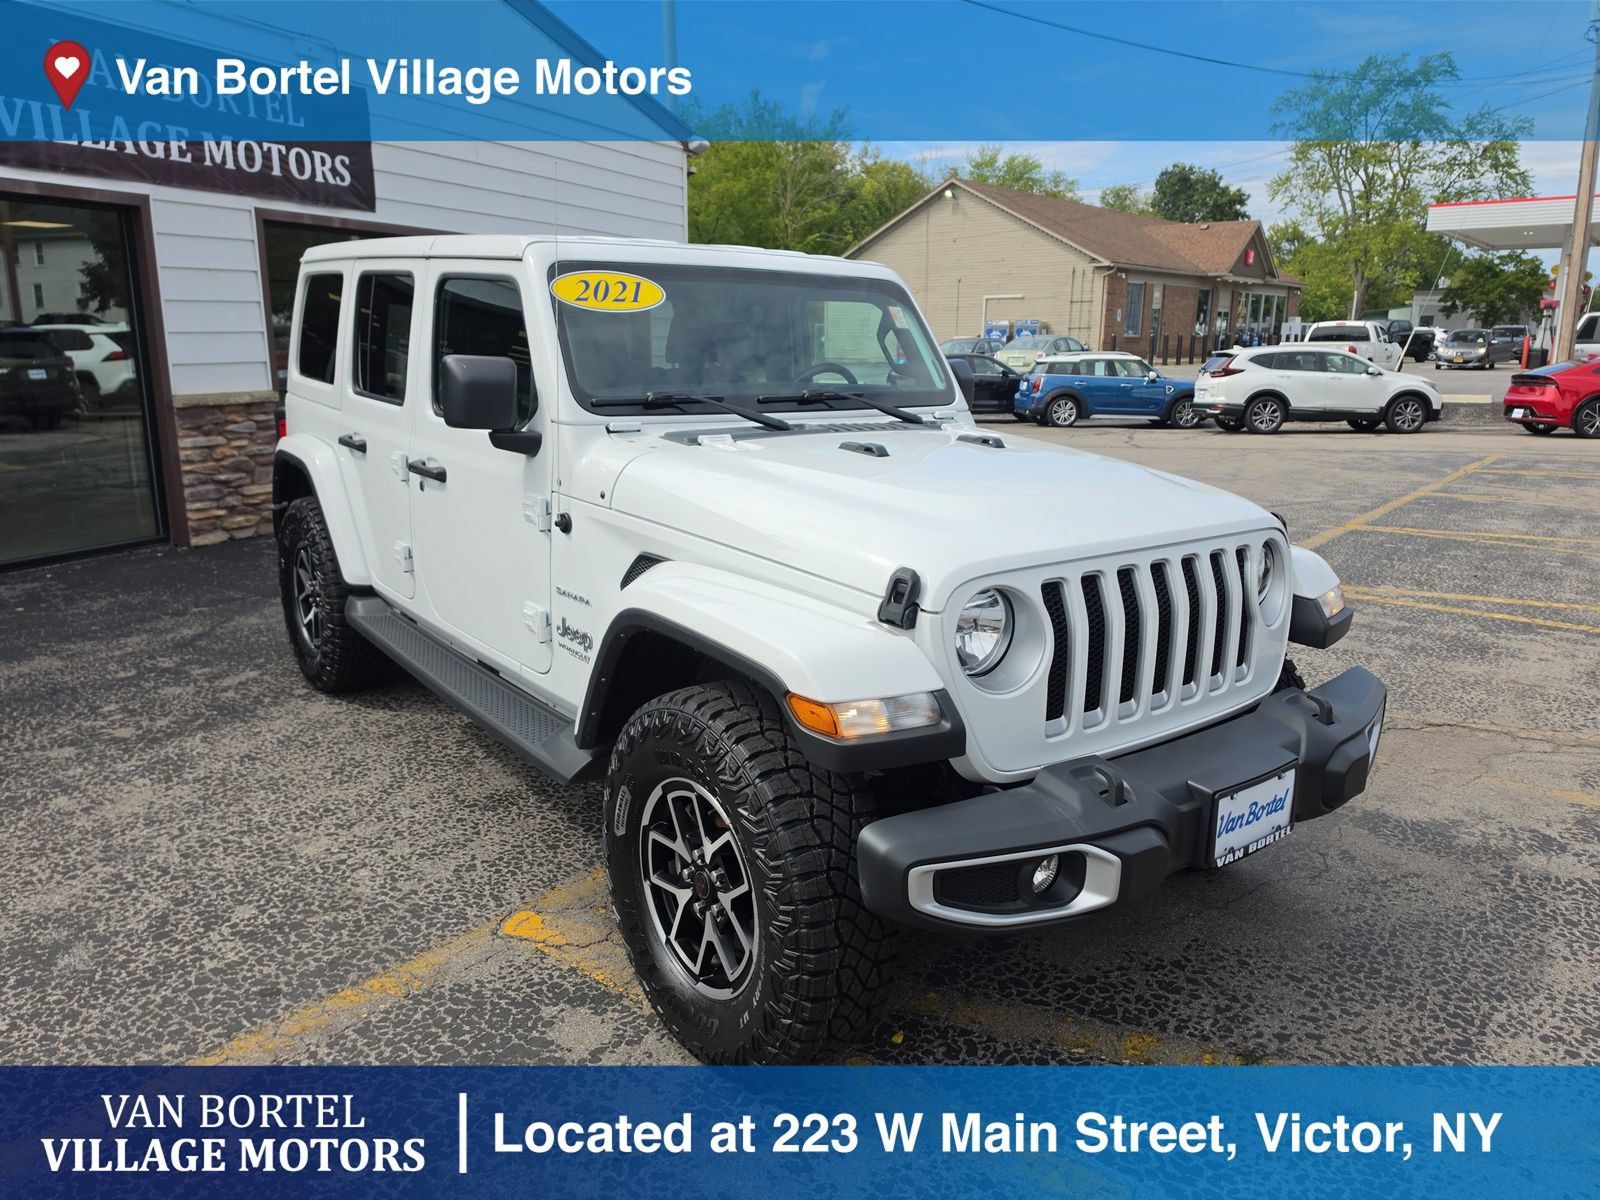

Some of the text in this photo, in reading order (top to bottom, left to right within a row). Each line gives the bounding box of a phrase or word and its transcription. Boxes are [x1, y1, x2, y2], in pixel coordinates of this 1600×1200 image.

[0, 95, 352, 187] VILLAGE MOTORS
[574, 279, 642, 303] 2021
[556, 586, 592, 608] SAHARA
[556, 616, 593, 653] Jeep
[1216, 787, 1290, 839] Van Bortel
[1215, 825, 1292, 868] VAN BORTEL
